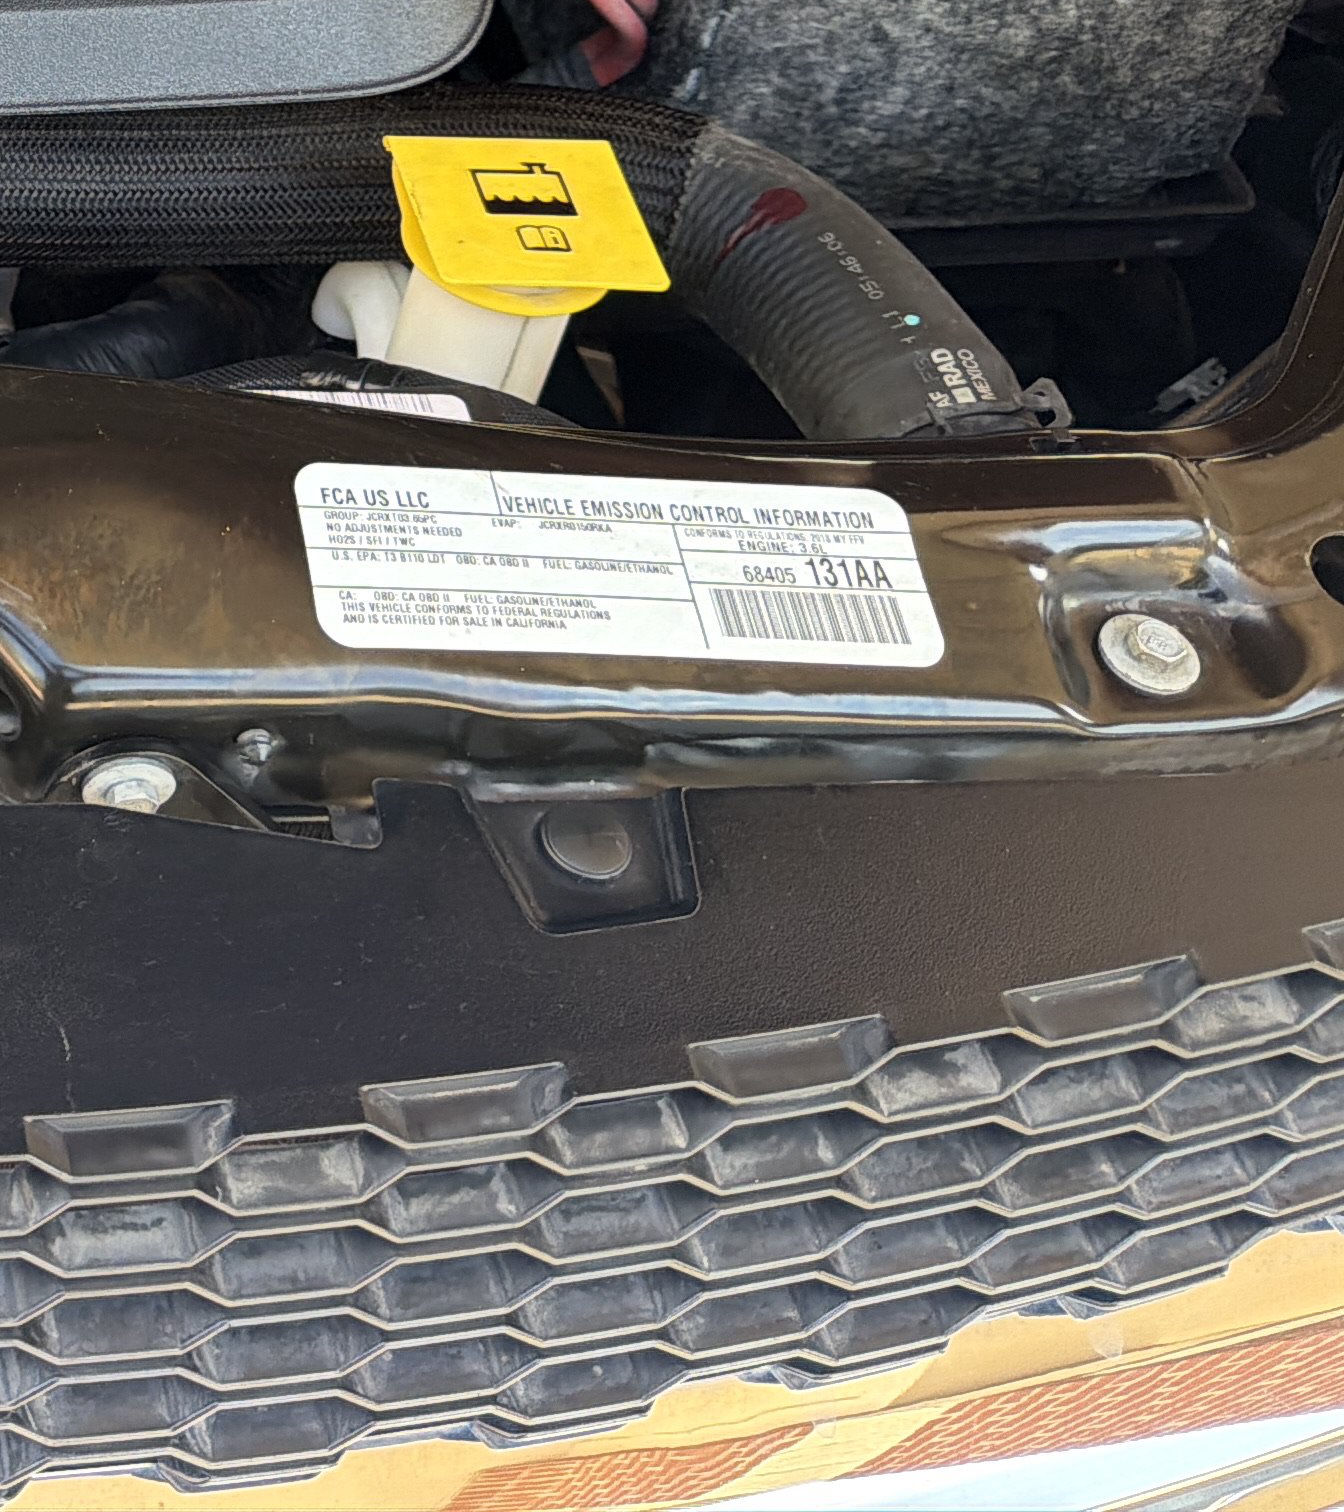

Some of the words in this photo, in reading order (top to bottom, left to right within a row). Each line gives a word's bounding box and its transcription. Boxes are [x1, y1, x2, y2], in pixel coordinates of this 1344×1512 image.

[931, 348, 967, 387] RAD
[957, 349, 997, 401] MEXICO
[928, 391, 953, 408] AF
[320, 487, 357, 505] FCA
[364, 489, 389, 506] US
[397, 490, 429, 508] LLC
[324, 510, 363, 521] GROUP:
[502, 495, 579, 516] VEHICLE
[582, 500, 664, 520] EMISSION
[670, 504, 749, 524] CONTROL
[754, 508, 874, 529] INFORMATION
[326, 523, 341, 532] NO
[345, 524, 419, 535] ADJUSTMENTS
[422, 526, 463, 537] NEEDED
[491, 518, 521, 529] EVAP:
[393, 537, 416, 546] TWC
[684, 528, 732, 539] CONFORMS
[735, 530, 744, 539] TO
[834, 535, 847, 544] MY
[739, 541, 795, 553] ENGINE:
[799, 542, 828, 555] 3.6L
[332, 551, 354, 561] U.S.
[357, 551, 381, 562] EPA:
[428, 553, 446, 564] LDT
[456, 555, 481, 565] OBD:
[483, 556, 496, 566] CA
[499, 557, 519, 568] OBD
[543, 559, 572, 570] FUEL:
[575, 560, 674, 575] GASOLINE/ETHANOL
[743, 565, 797, 584] 68405
[804, 558, 894, 589] 131AA
[339, 591, 357, 600] CA:
[374, 591, 399, 602] OBD:
[401, 592, 417, 602] CA
[420, 592, 439, 602] OBD
[464, 593, 494, 604] FUEL:
[496, 595, 597, 609] GASOLINE/ETHANOL
[341, 602, 365, 612] THIS
[369, 603, 412, 614] VEHICLE
[415, 604, 473, 615] CONFORMS
[476, 605, 490, 615] TO
[493, 606, 537, 617] FEDERAL
[541, 607, 611, 620] REGULATIONS
[343, 613, 365, 623] AND
[368, 614, 379, 624] IS
[382, 615, 436, 626] CERTIFIED
[439, 616, 460, 626] FOR
[463, 617, 489, 627] SALE
[491, 618, 503, 628] IN
[506, 618, 567, 630] CALIFORNIA
